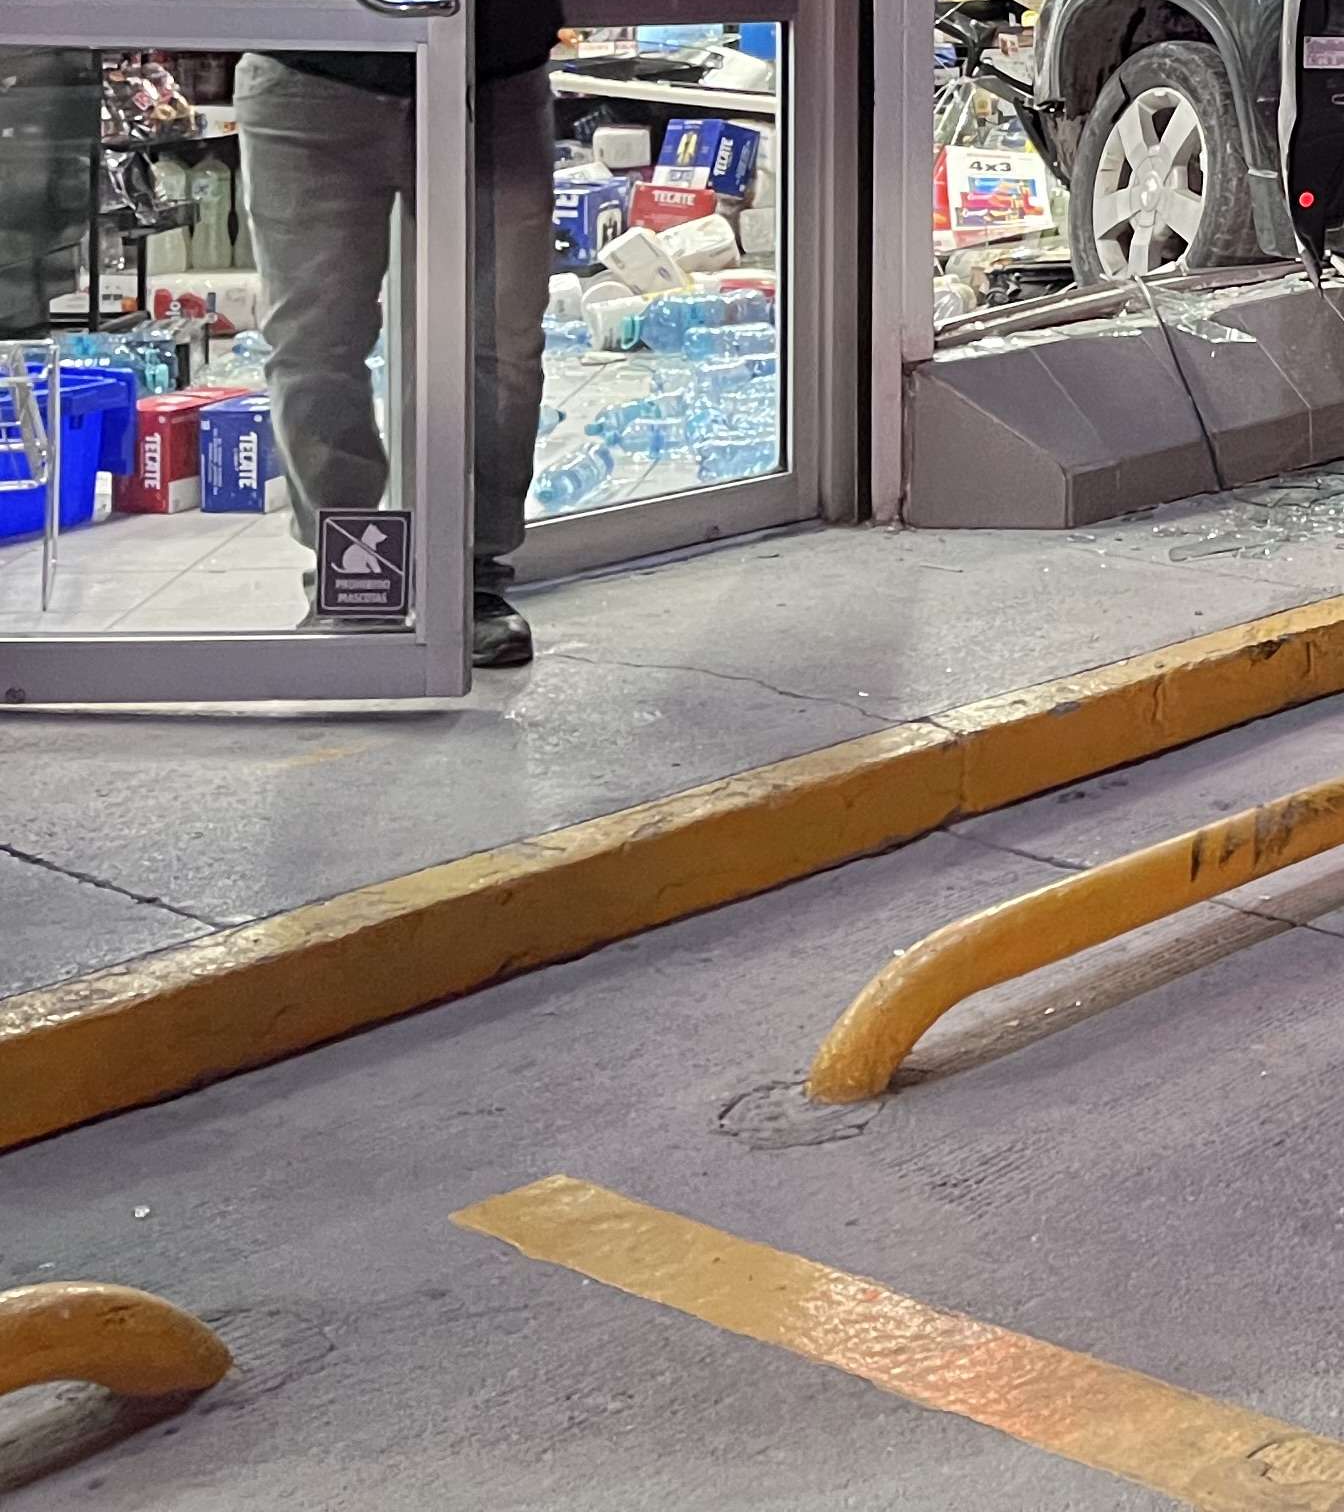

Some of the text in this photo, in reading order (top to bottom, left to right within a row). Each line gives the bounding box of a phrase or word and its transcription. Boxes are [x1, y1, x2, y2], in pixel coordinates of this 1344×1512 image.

[713, 136, 734, 177] TECATE
[968, 160, 1012, 172] 4x3
[651, 190, 697, 206] TECATE
[143, 432, 162, 490] TECATE
[238, 431, 258, 490] TECATE
